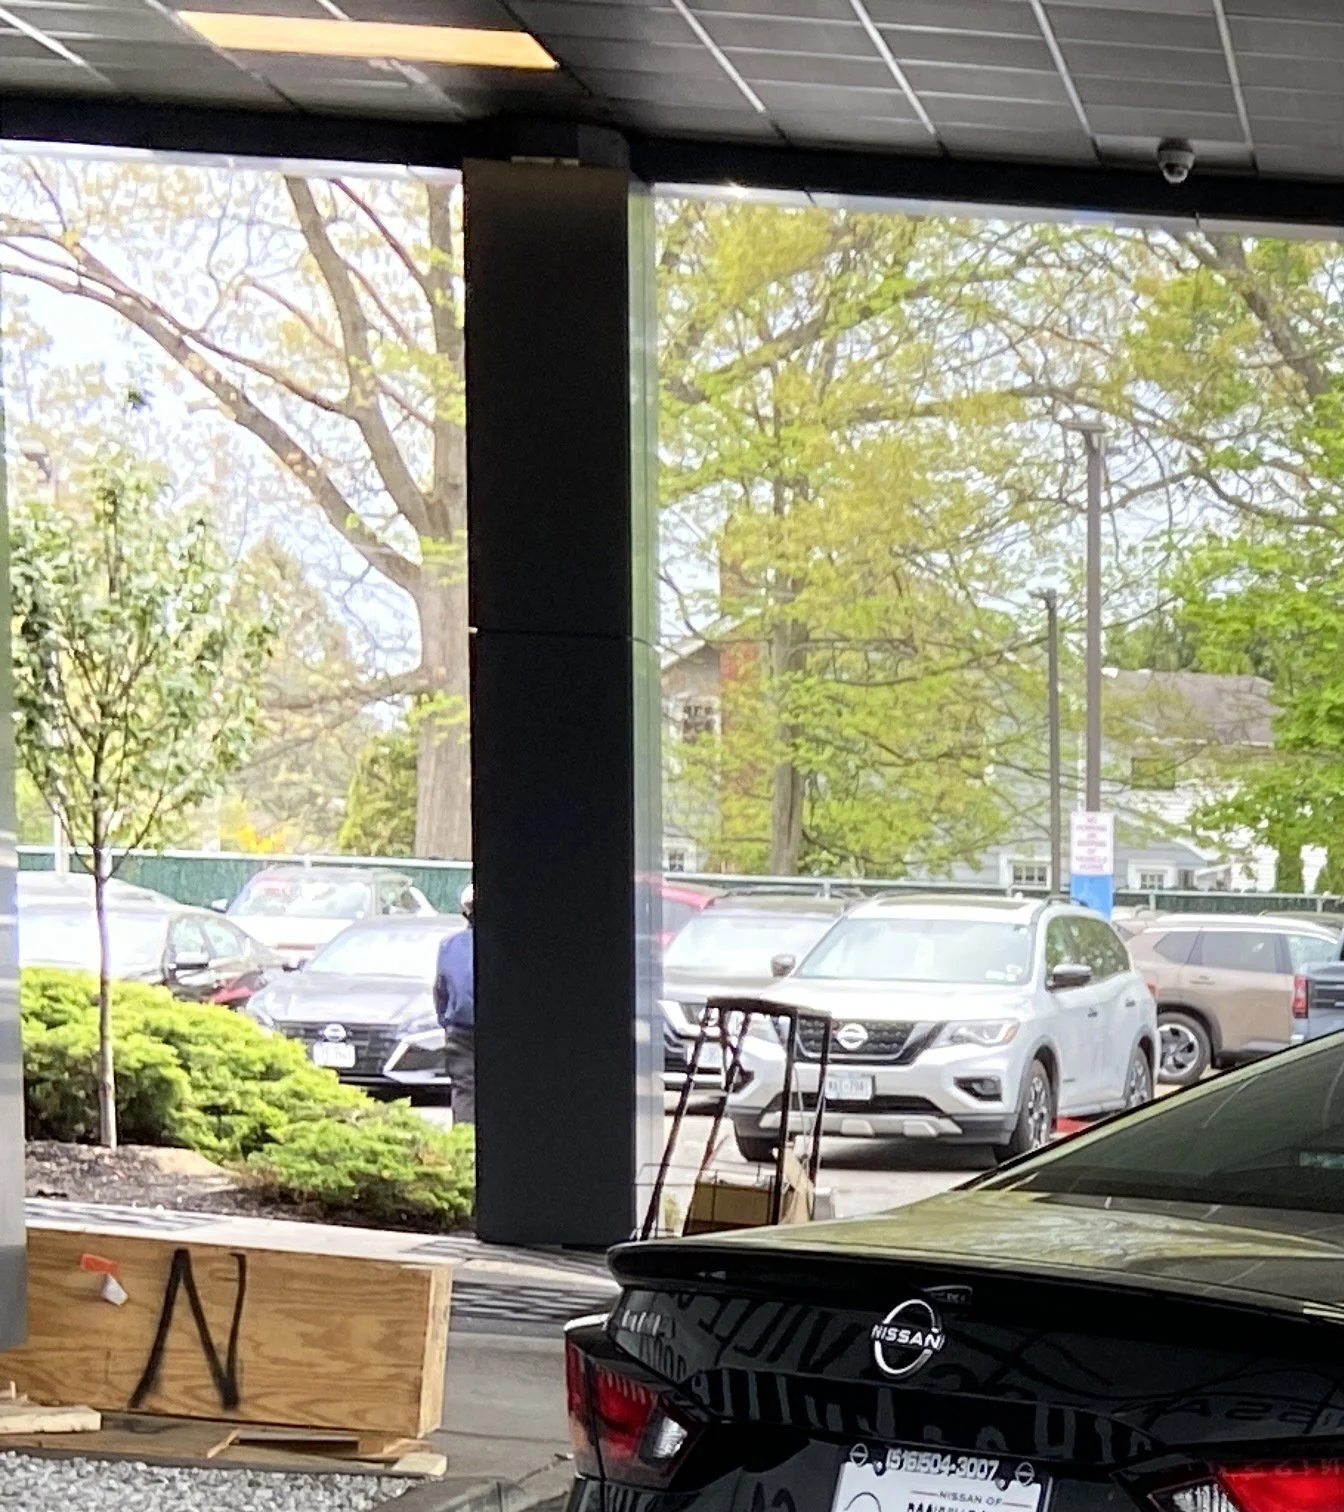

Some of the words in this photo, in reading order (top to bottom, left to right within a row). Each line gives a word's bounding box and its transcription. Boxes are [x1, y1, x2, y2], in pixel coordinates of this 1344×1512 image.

[128, 1247, 248, 1412] N
[870, 1324, 945, 1351] NISSAN
[938, 1490, 983, 1505] NISSAN
[985, 1496, 1003, 1507] OF
